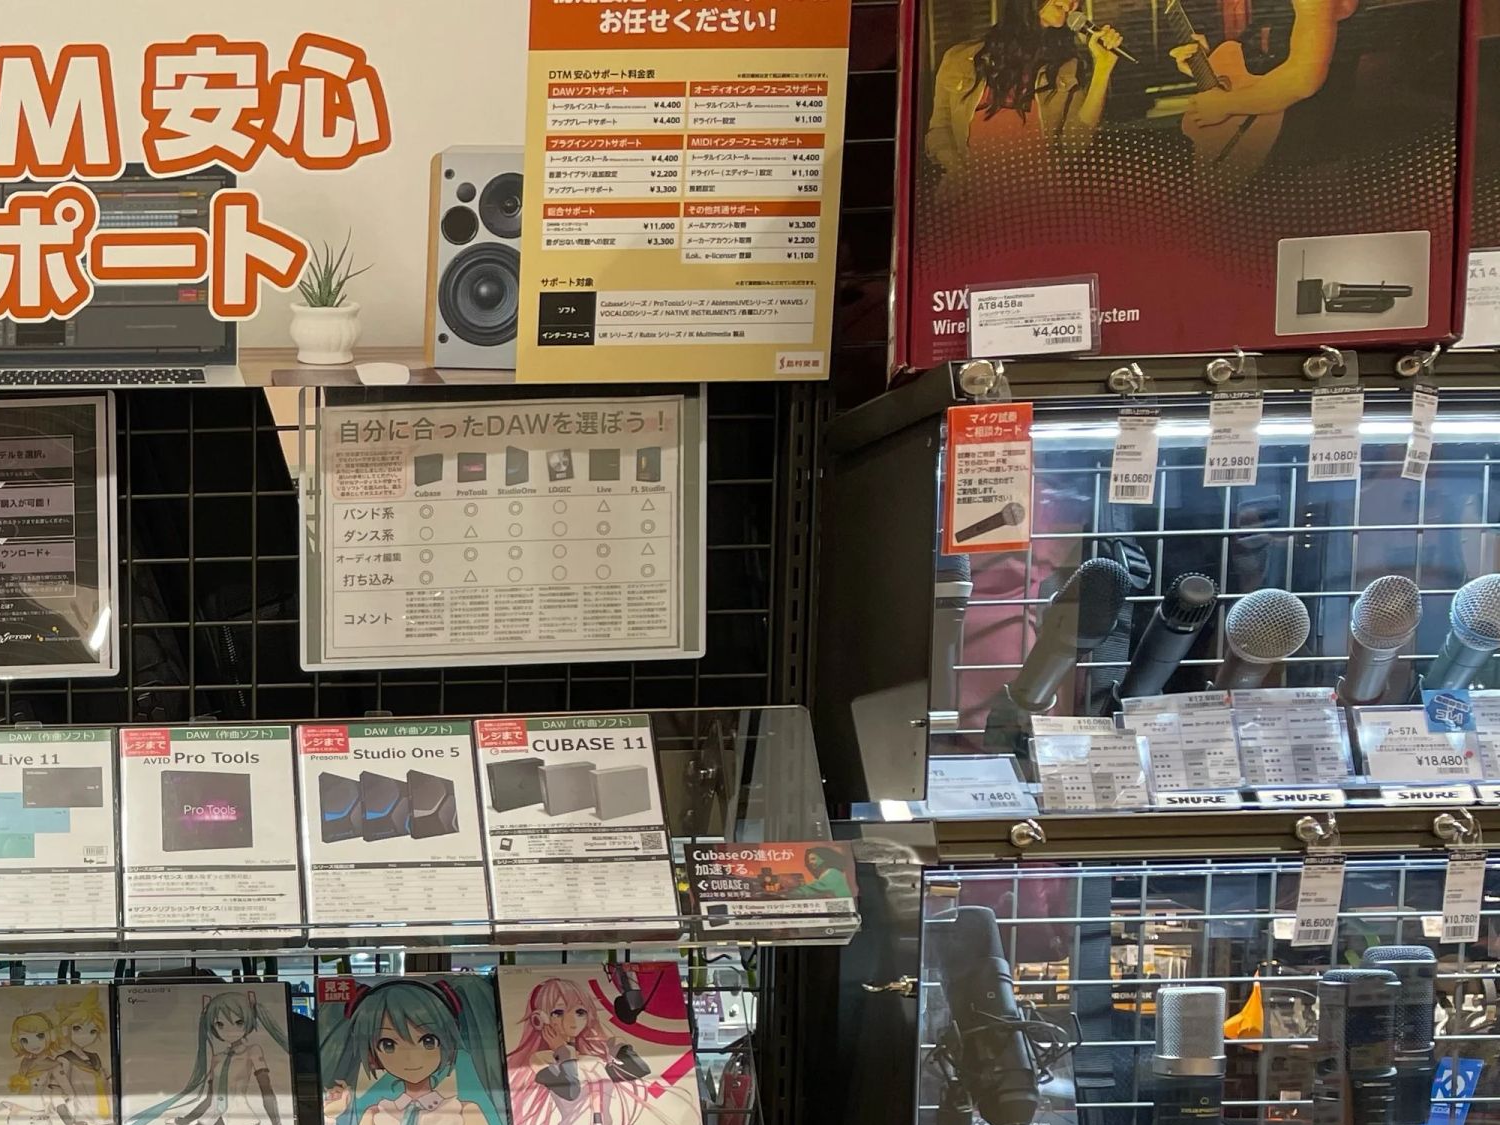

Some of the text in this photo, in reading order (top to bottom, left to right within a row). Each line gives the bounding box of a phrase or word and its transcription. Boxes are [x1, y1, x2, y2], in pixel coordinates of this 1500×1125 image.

[549, 69, 655, 79] DTM 安心サポート料金表
[552, 85, 629, 96] DAWソフトサポート
[142, 33, 392, 176] 安心
[932, 288, 969, 312] SVX
[933, 319, 970, 336] Wirel
[1033, 325, 1075, 337] ¥4,400
[340, 411, 665, 443] 自分に合ったDAWを選ぼう！
[343, 507, 394, 520] バンド系
[344, 529, 395, 542] ダンス系
[343, 573, 394, 586] 打ち込み
[344, 612, 393, 625] コメント
[532, 737, 648, 752] CUBASE 11
[0, 754, 34, 766] Live
[39, 754, 60, 765] 11
[143, 751, 259, 765] AVID Pro Tools
[354, 748, 406, 760] Studio
[412, 748, 445, 759] One
[450, 747, 460, 758] 5
[1416, 755, 1463, 766] ¥18,480
[1167, 795, 1226, 804] SHURE
[1273, 793, 1331, 803] SHURE
[693, 849, 794, 862] Cubaseの進化が
